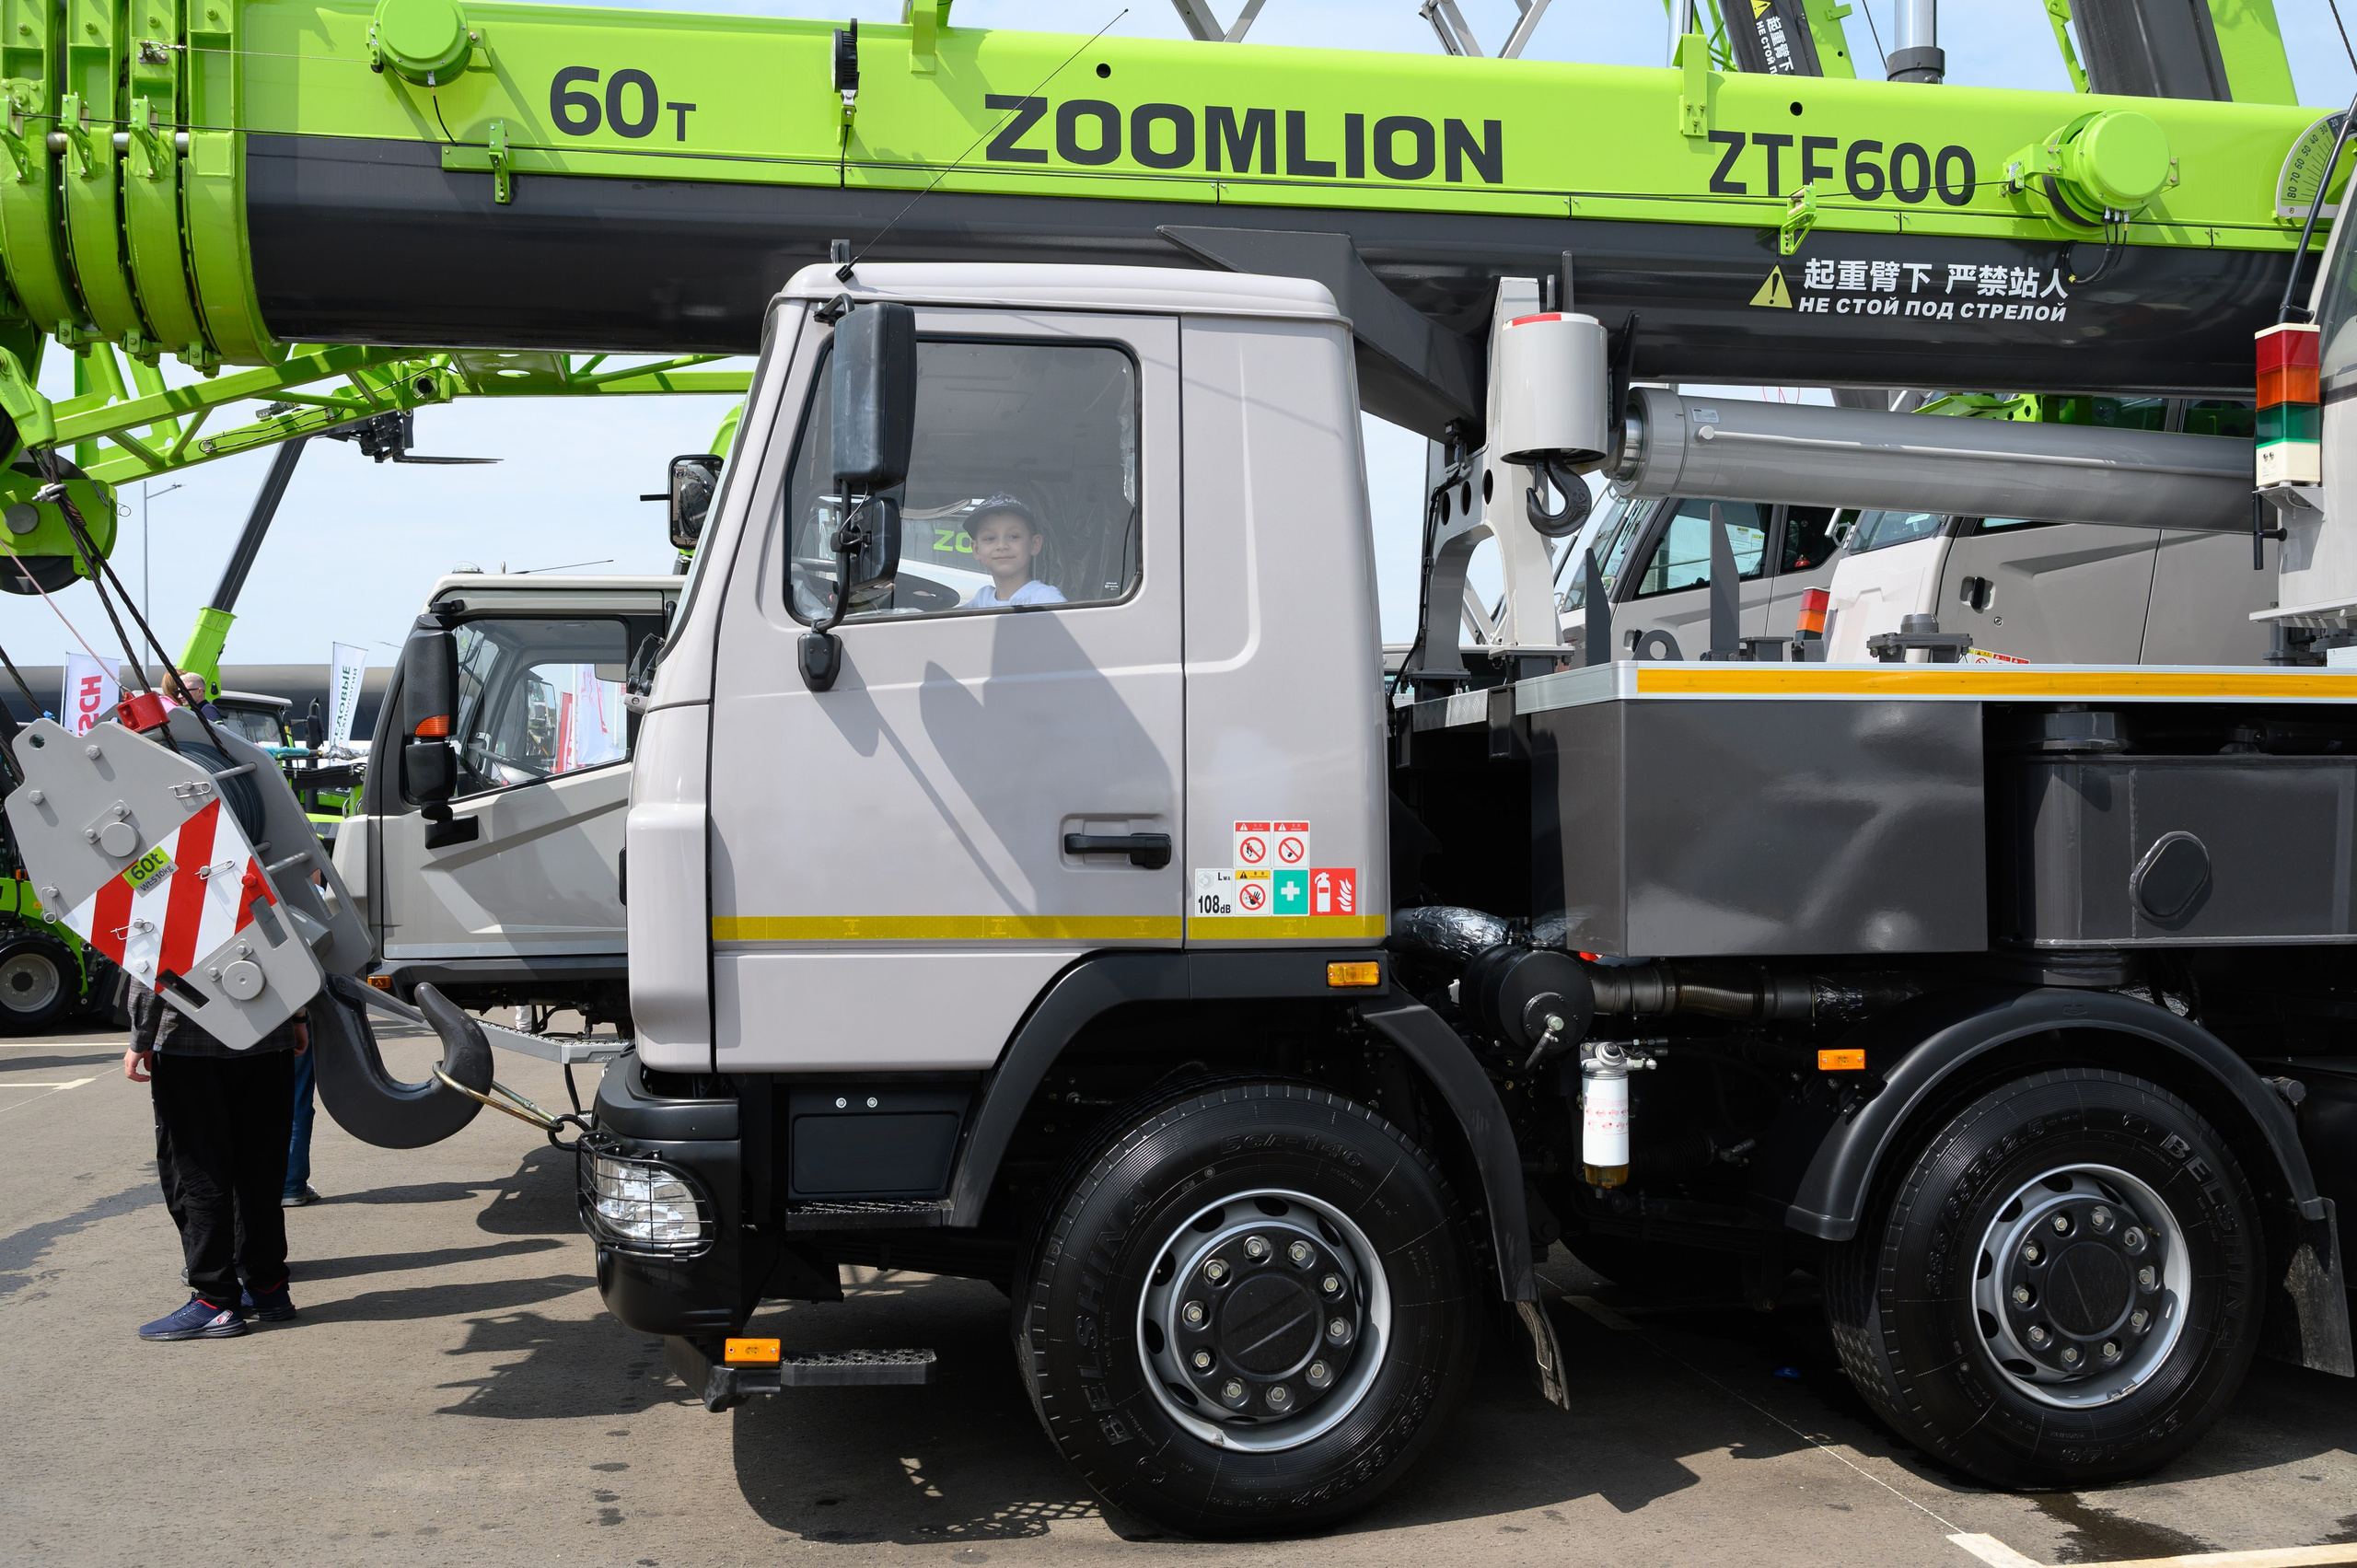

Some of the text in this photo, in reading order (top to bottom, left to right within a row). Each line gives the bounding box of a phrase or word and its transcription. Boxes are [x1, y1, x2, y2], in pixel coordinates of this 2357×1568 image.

[1756, 20, 1767, 37] НЕ
[1760, 36, 1776, 65] СТОЙ
[985, 93, 1504, 184] ZOOMLION
[2309, 134, 2319, 145] 40
[2318, 124, 2328, 135] 30
[2294, 157, 2305, 169] 60
[2301, 145, 2312, 157] 50
[1708, 130, 1977, 206] ZTF600
[2290, 171, 2300, 183] 70
[2287, 186, 2297, 199] 80
[1804, 258, 2069, 299] 起重臂下 严禁站人
[1798, 296, 2067, 322] НЕ СТОЙ ПОД СТРЕЛОЙ
[78, 675, 102, 738] SCH
[130, 853, 164, 880] 60t
[1198, 894, 1231, 914] 108dB
[2160, 1131, 2246, 1351] BELSHINA
[1075, 1188, 1152, 1446] BELSHINA
